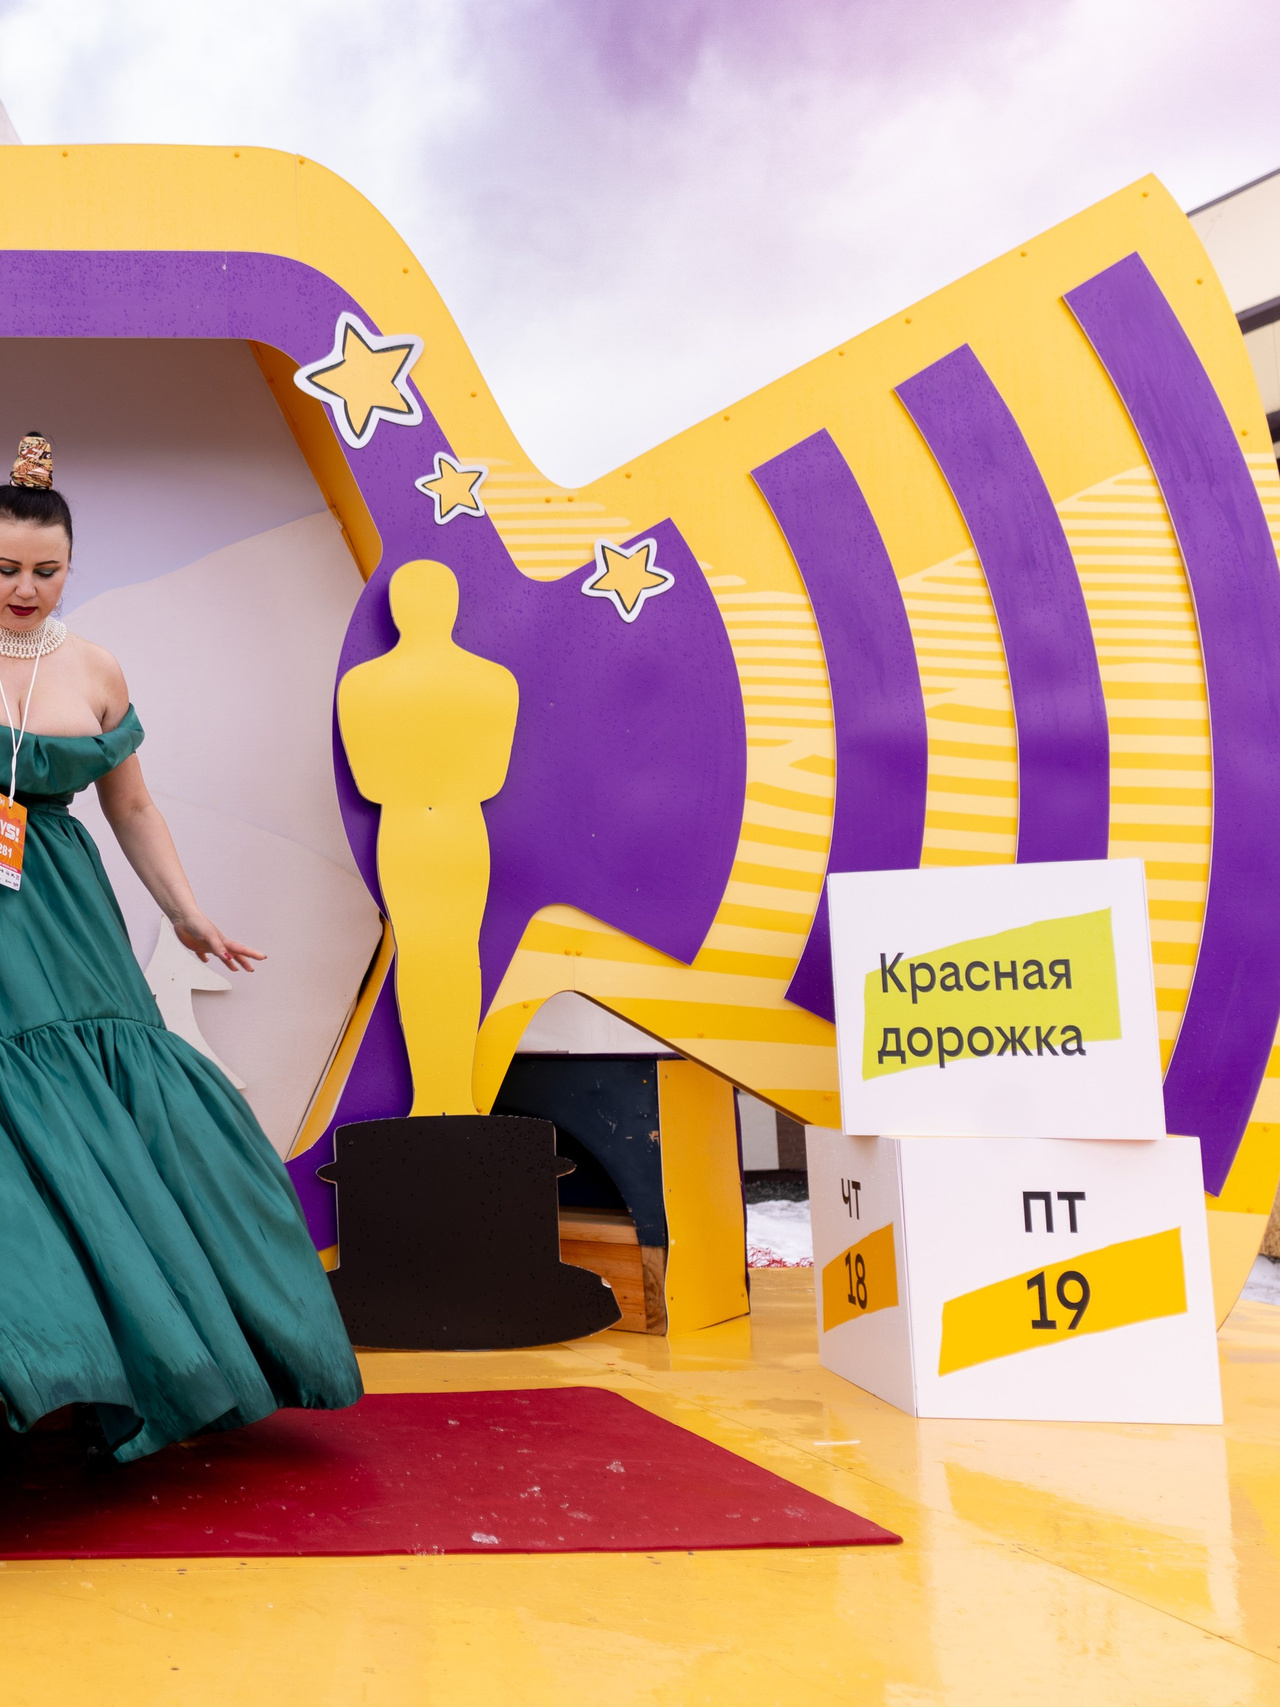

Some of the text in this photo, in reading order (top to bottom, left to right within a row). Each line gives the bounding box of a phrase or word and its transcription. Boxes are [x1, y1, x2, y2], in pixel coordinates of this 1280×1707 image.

[879, 951, 1073, 1005] Красная
[877, 1022, 1087, 1069] дорожка
[840, 1177, 862, 1220] ЧТ
[1022, 1190, 1087, 1234] ПТ
[844, 1251, 868, 1310] 18
[1026, 1269, 1092, 1331] 19
